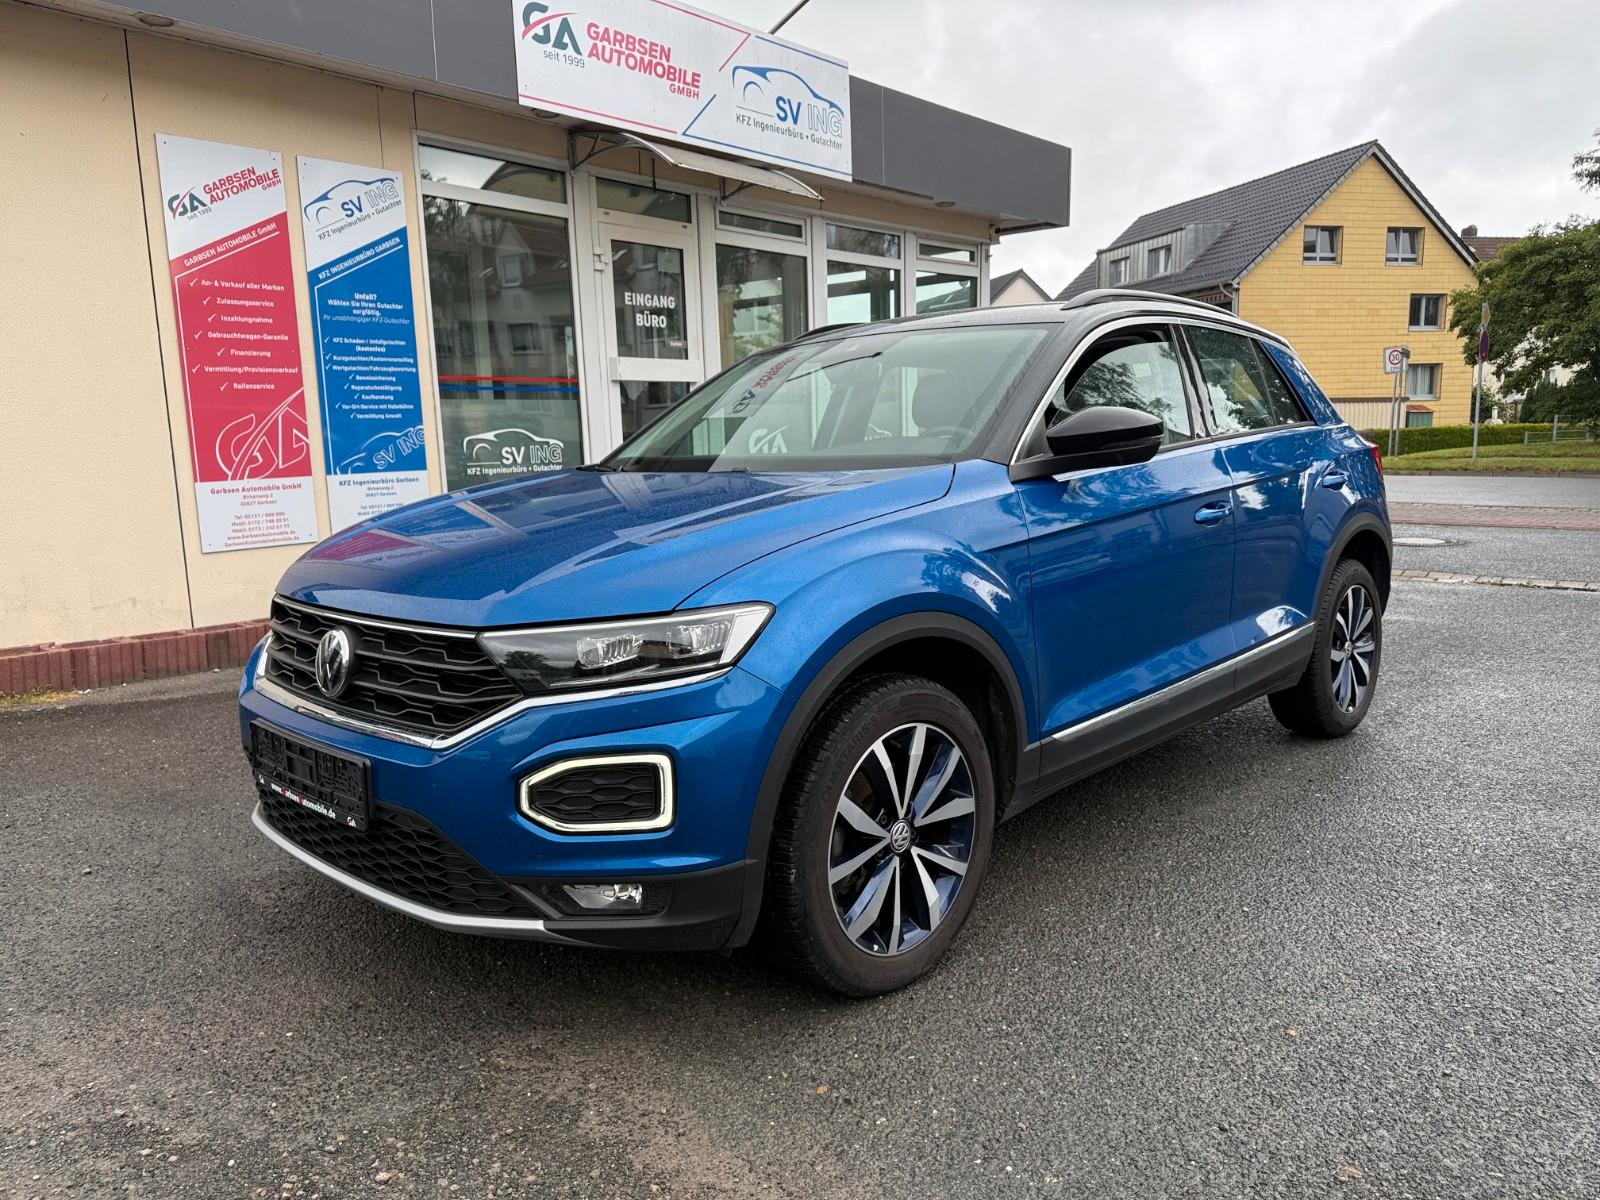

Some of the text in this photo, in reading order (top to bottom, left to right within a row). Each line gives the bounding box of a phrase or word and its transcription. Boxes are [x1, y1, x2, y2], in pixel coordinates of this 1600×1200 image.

[586, 22, 671, 63] GARBSEN
[543, 50, 585, 68] seit 1999
[587, 43, 701, 89] AUTOMOBILE
[669, 83, 700, 100] GMBH
[776, 96, 843, 138] SV ING
[736, 113, 842, 150] KFZ Ingenieurbüro Gutachter
[203, 166, 256, 195] GARBSEN
[209, 168, 280, 205] AUTOMOBILE
[261, 178, 282, 191] GMBH
[341, 181, 399, 218] SV ING
[199, 206, 212, 216] 1999
[318, 199, 402, 240] KFZ Ingenieurbüro Gutachter
[184, 222, 277, 266] GARBSEN AUTOMOBILE GmbH
[318, 236, 401, 280] KFZ INGENIEURBÜRO GARBSEN
[261, 283, 284, 291] Marken
[217, 297, 274, 307] Zulassungsservice
[354, 292, 377, 300] Unfall?
[624, 292, 676, 309] EINGANG
[377, 302, 404, 310] Gutachter
[221, 315, 273, 324] Inzahlungnahme
[635, 310, 667, 328] BÜRO
[207, 331, 288, 340] Gebrauchtwagen-Garantie
[231, 349, 271, 358] Finanzierung
[204, 365, 298, 374] Vermittlung/Provisionsverkauf
[373, 445, 396, 470] SV
[501, 444, 563, 465] SV ING
[467, 464, 562, 476] KFZ Ingenieurbüro Gutachter
[210, 487, 239, 495] Garbsen
[241, 485, 280, 493] Automobile
[352, 478, 395, 487] Ingenieurbüro
